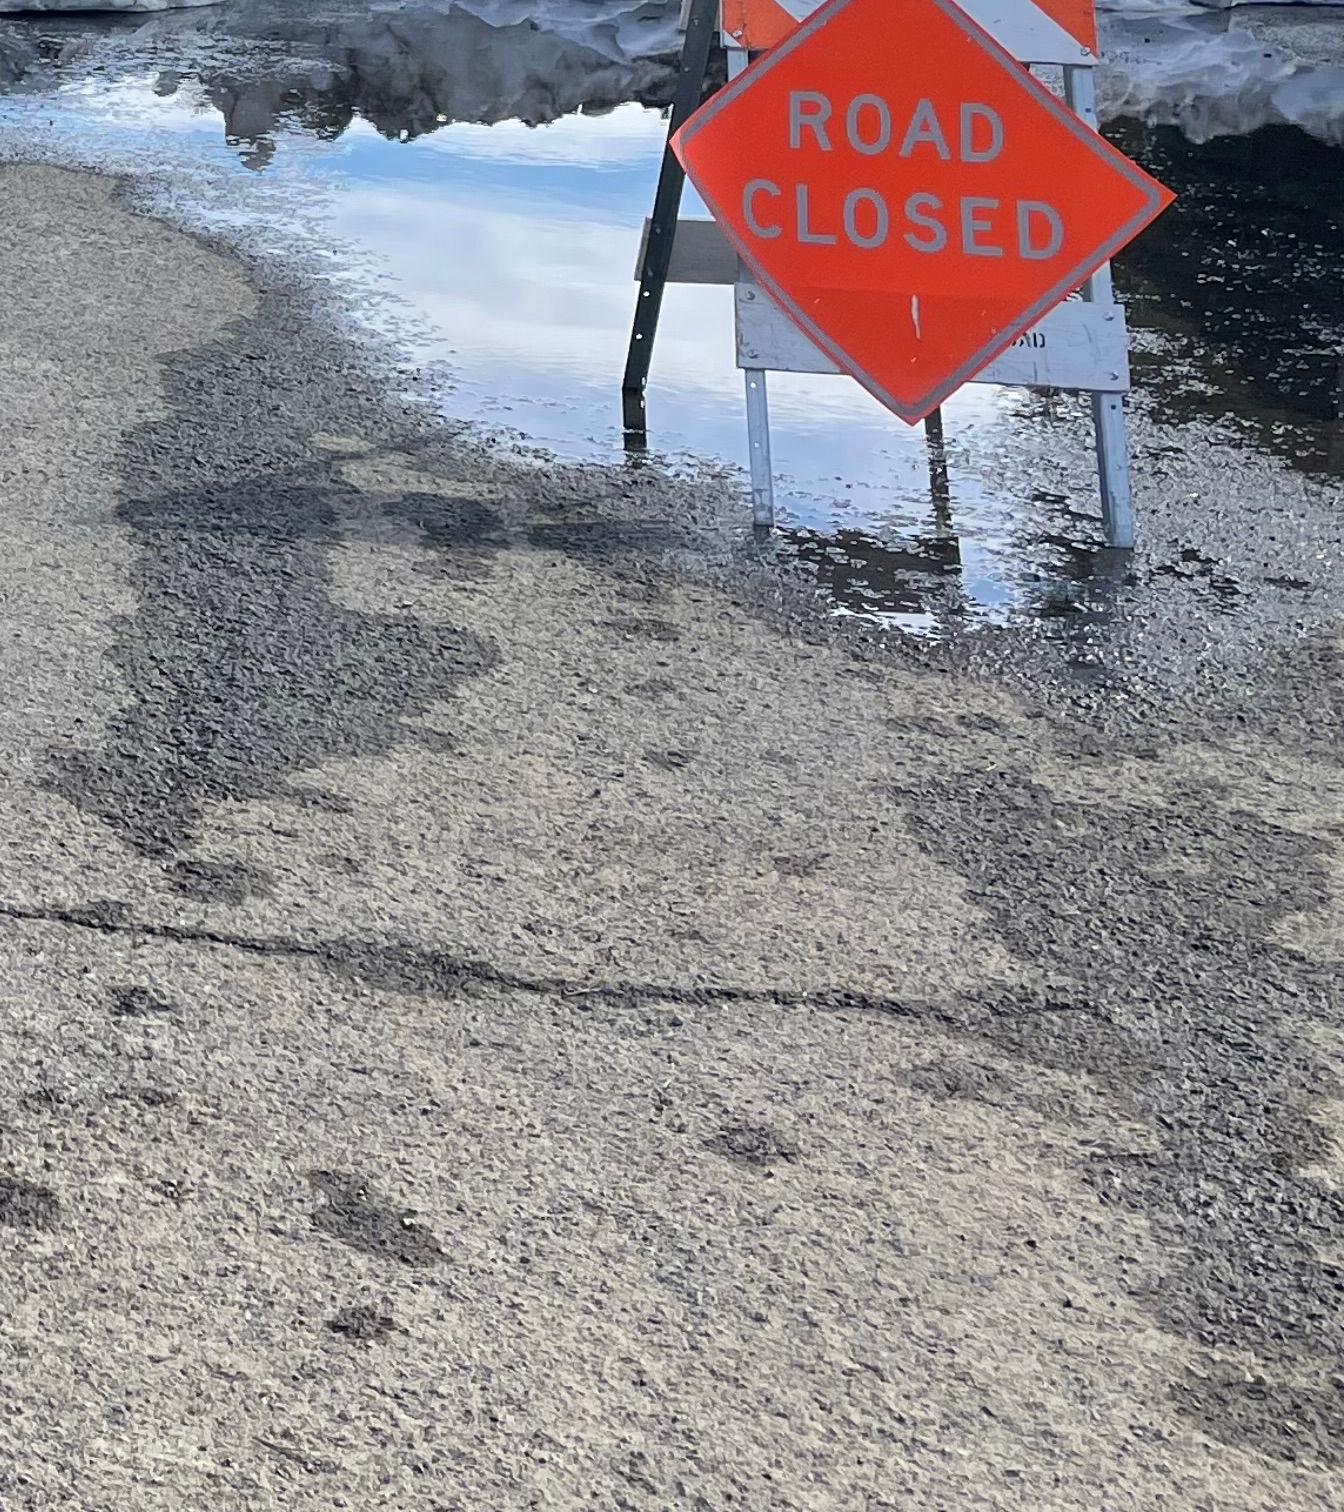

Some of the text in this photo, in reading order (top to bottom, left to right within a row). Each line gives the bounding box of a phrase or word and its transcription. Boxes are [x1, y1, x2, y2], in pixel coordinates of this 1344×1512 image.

[787, 90, 1005, 163] ROAD
[742, 179, 1063, 260] CLOSED
[1012, 332, 1046, 349] AD
